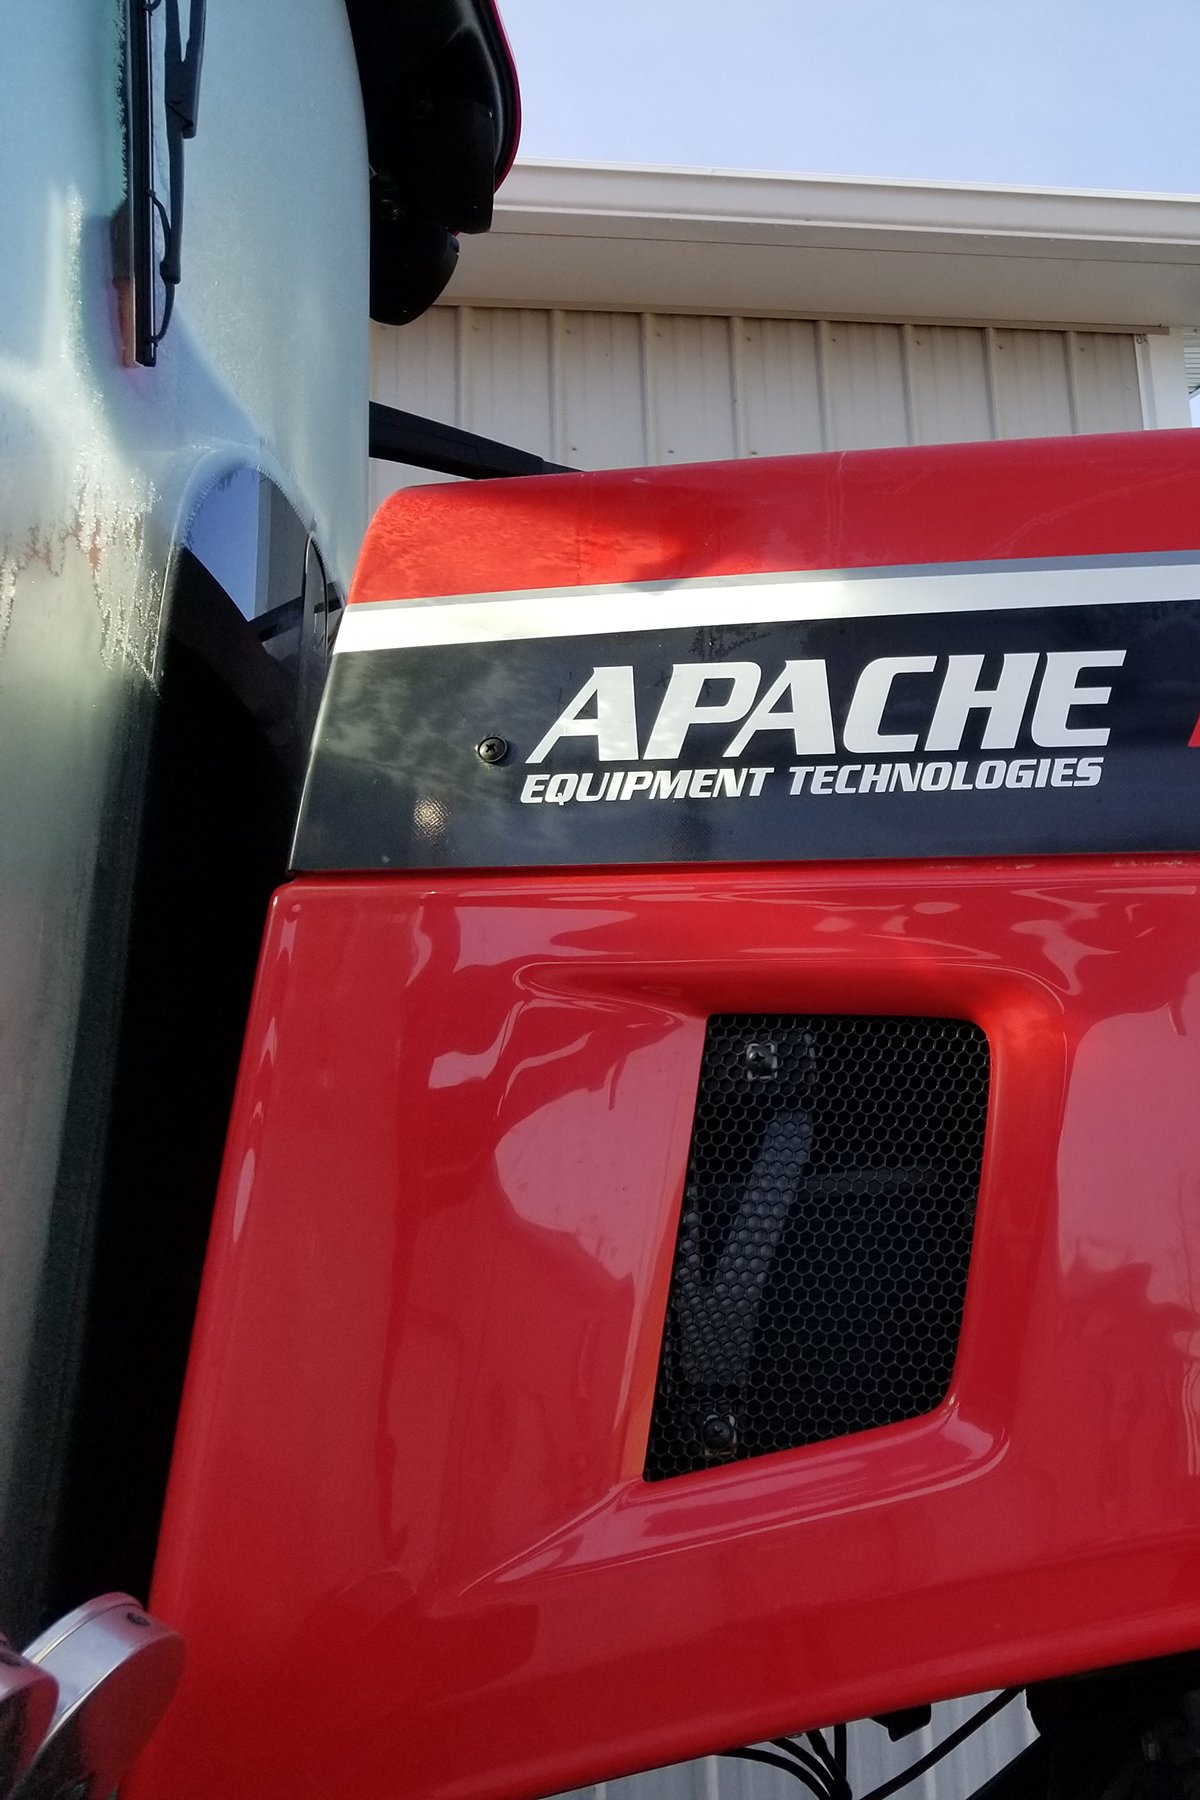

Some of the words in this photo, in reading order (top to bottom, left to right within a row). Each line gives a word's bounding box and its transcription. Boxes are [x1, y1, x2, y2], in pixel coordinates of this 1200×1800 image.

[525, 650, 1127, 764] APACHE
[520, 767, 775, 806] EQUIPMENT
[789, 757, 1104, 796] TECHNOLOGIES
